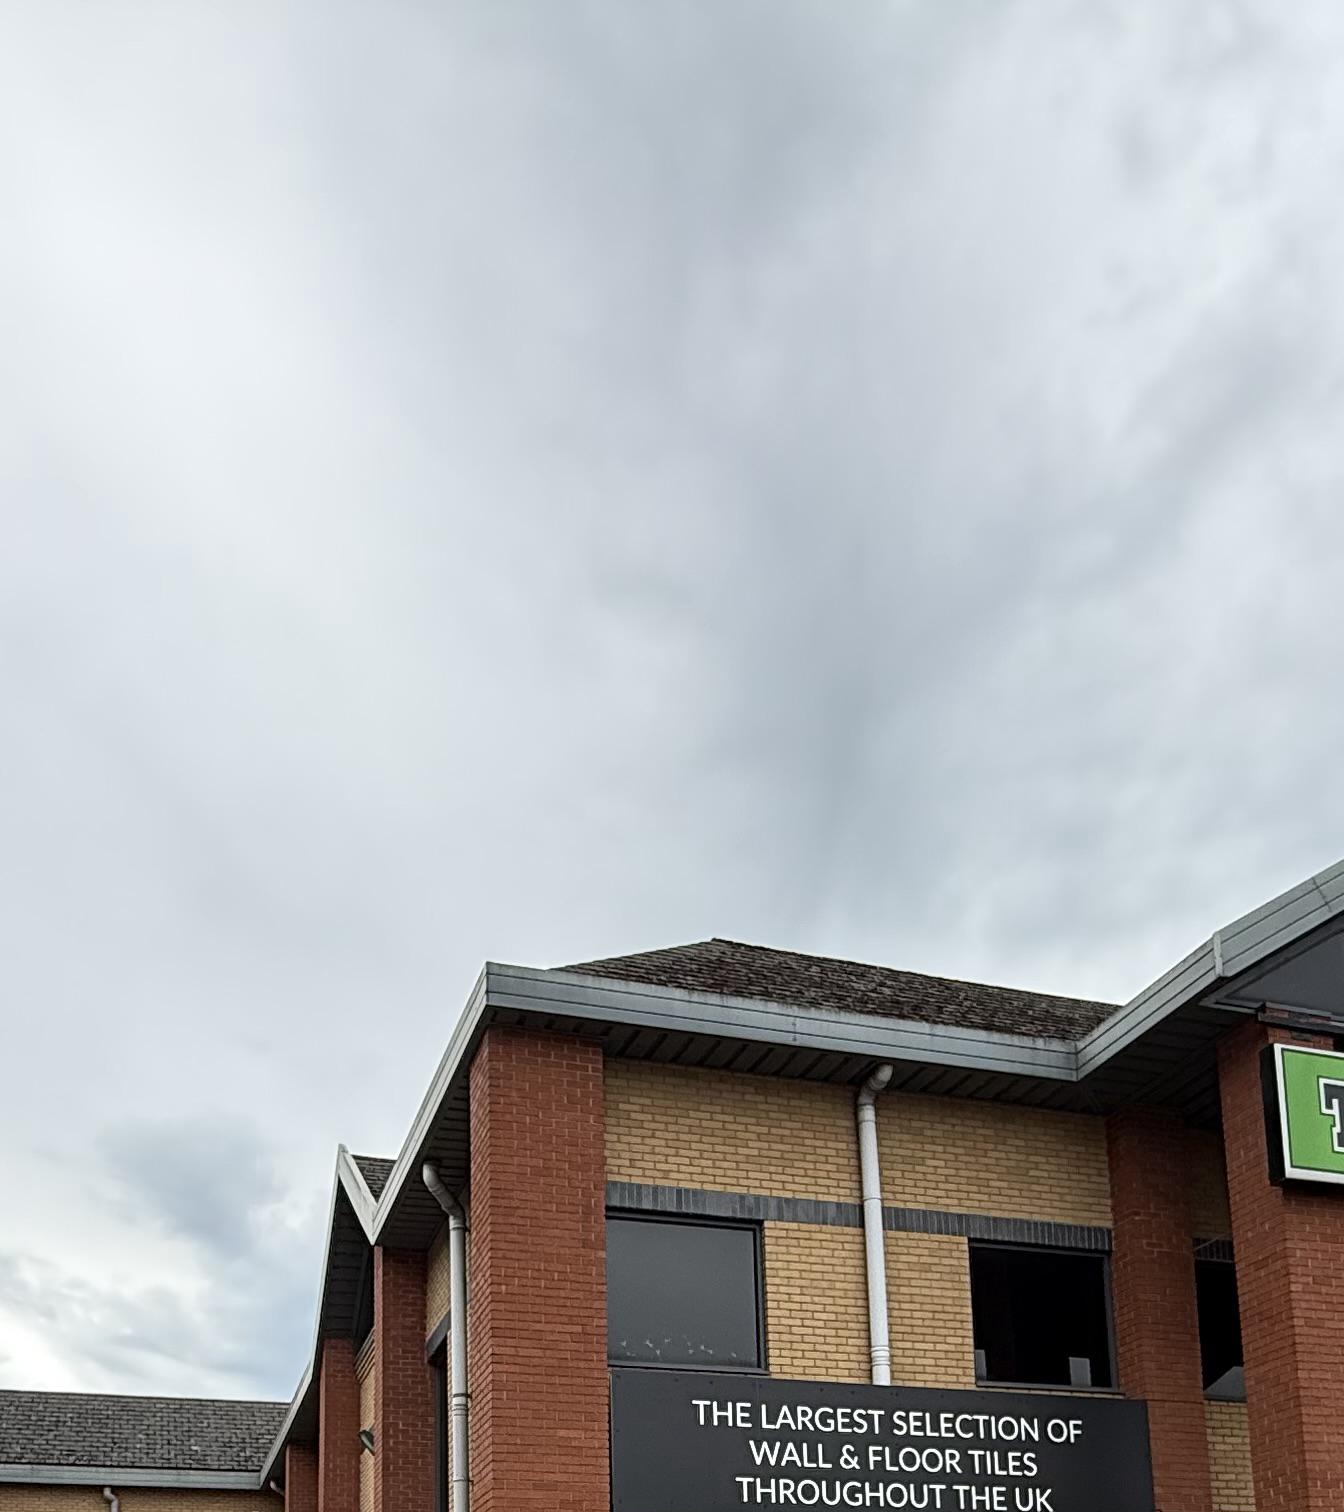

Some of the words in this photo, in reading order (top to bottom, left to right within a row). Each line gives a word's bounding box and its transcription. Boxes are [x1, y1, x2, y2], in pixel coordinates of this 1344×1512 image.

[692, 1400, 753, 1428] THE
[760, 1404, 885, 1435] LARGEST
[892, 1411, 1040, 1443] SELECTION
[1046, 1418, 1083, 1444] OF
[749, 1440, 833, 1470] WALL
[839, 1445, 860, 1470] &
[868, 1446, 963, 1474] FLOOR
[967, 1450, 1038, 1477] TILES
[735, 1476, 947, 1509] THROUGHOUT
[953, 1485, 1007, 1512] THE
[1015, 1488, 1055, 1512] UK
